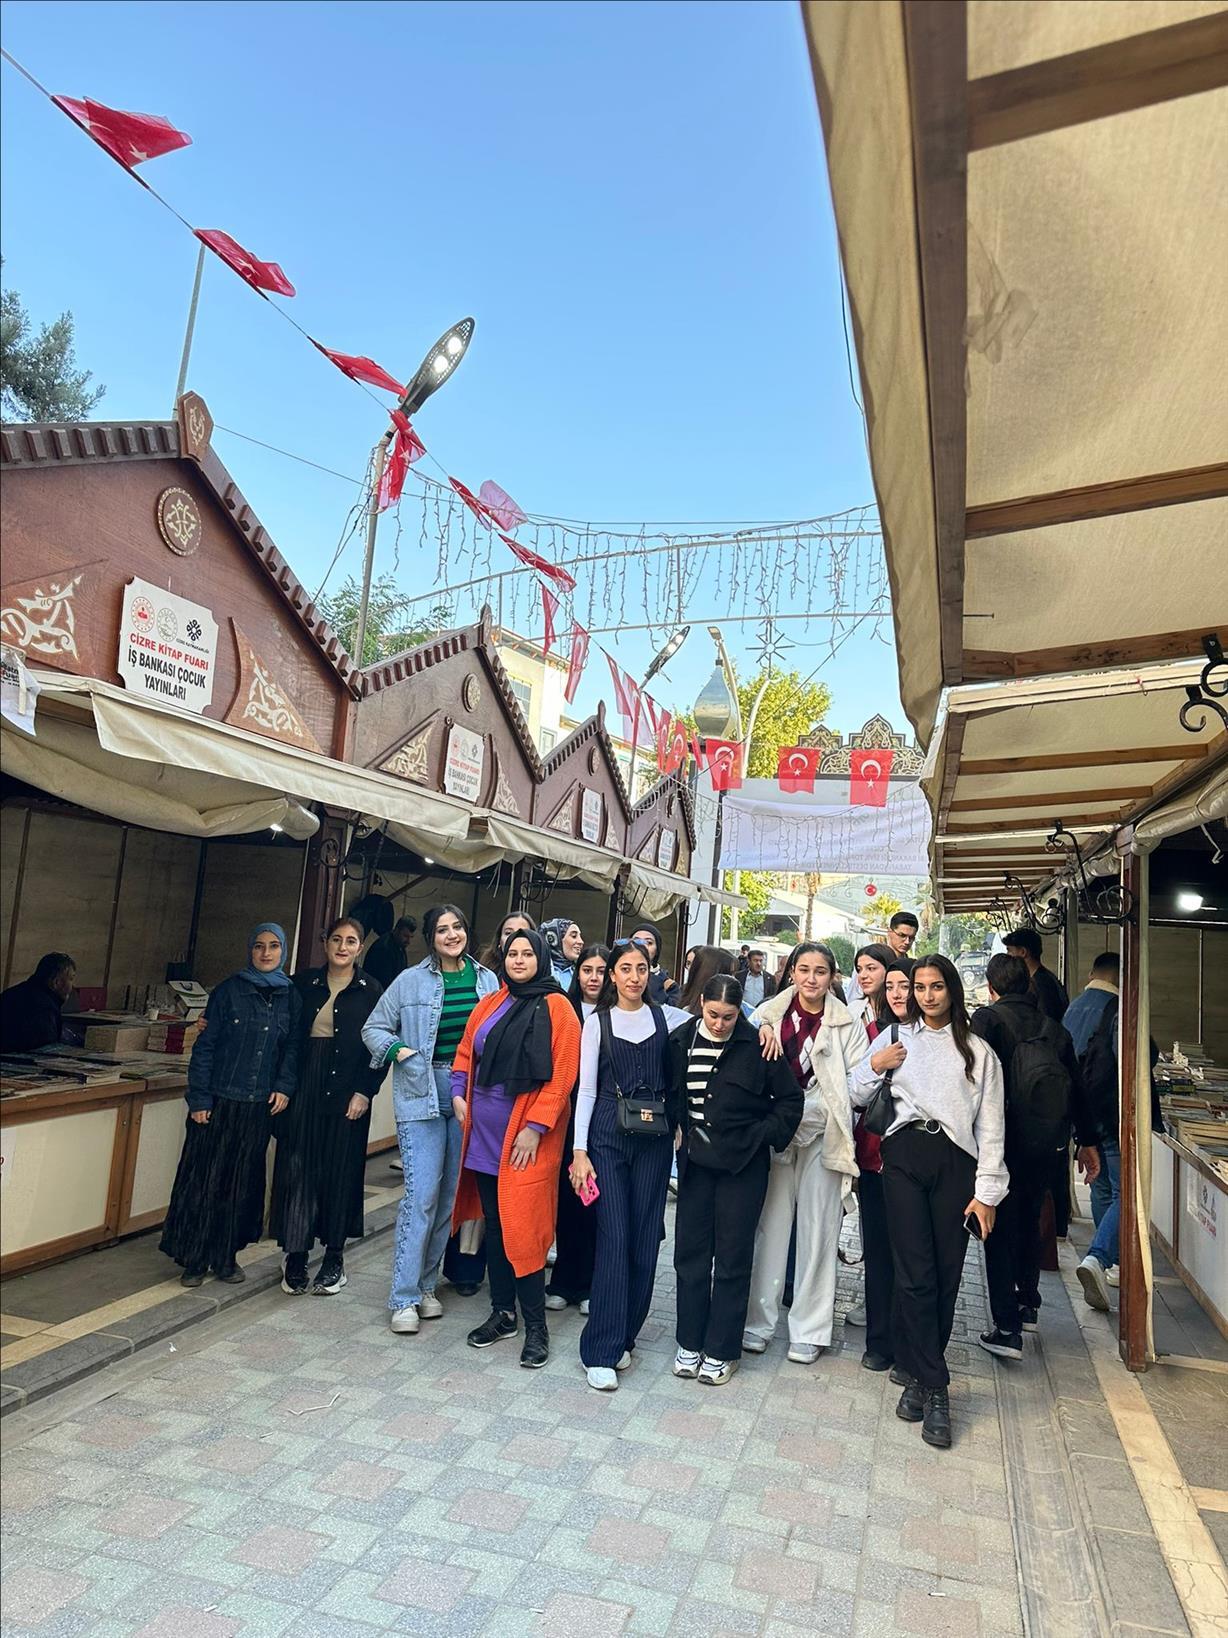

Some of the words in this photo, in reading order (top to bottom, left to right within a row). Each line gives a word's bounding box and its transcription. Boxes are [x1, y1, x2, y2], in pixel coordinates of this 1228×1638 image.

[128, 645, 137, 667] İŞ
[139, 653, 176, 678] BANKASI
[178, 667, 206, 688] ÇOCUK
[130, 632, 156, 651] CİZRE
[158, 643, 183, 660] KİTAP
[184, 654, 209, 671] FUARI
[144, 674, 186, 700] YAYINLARI
